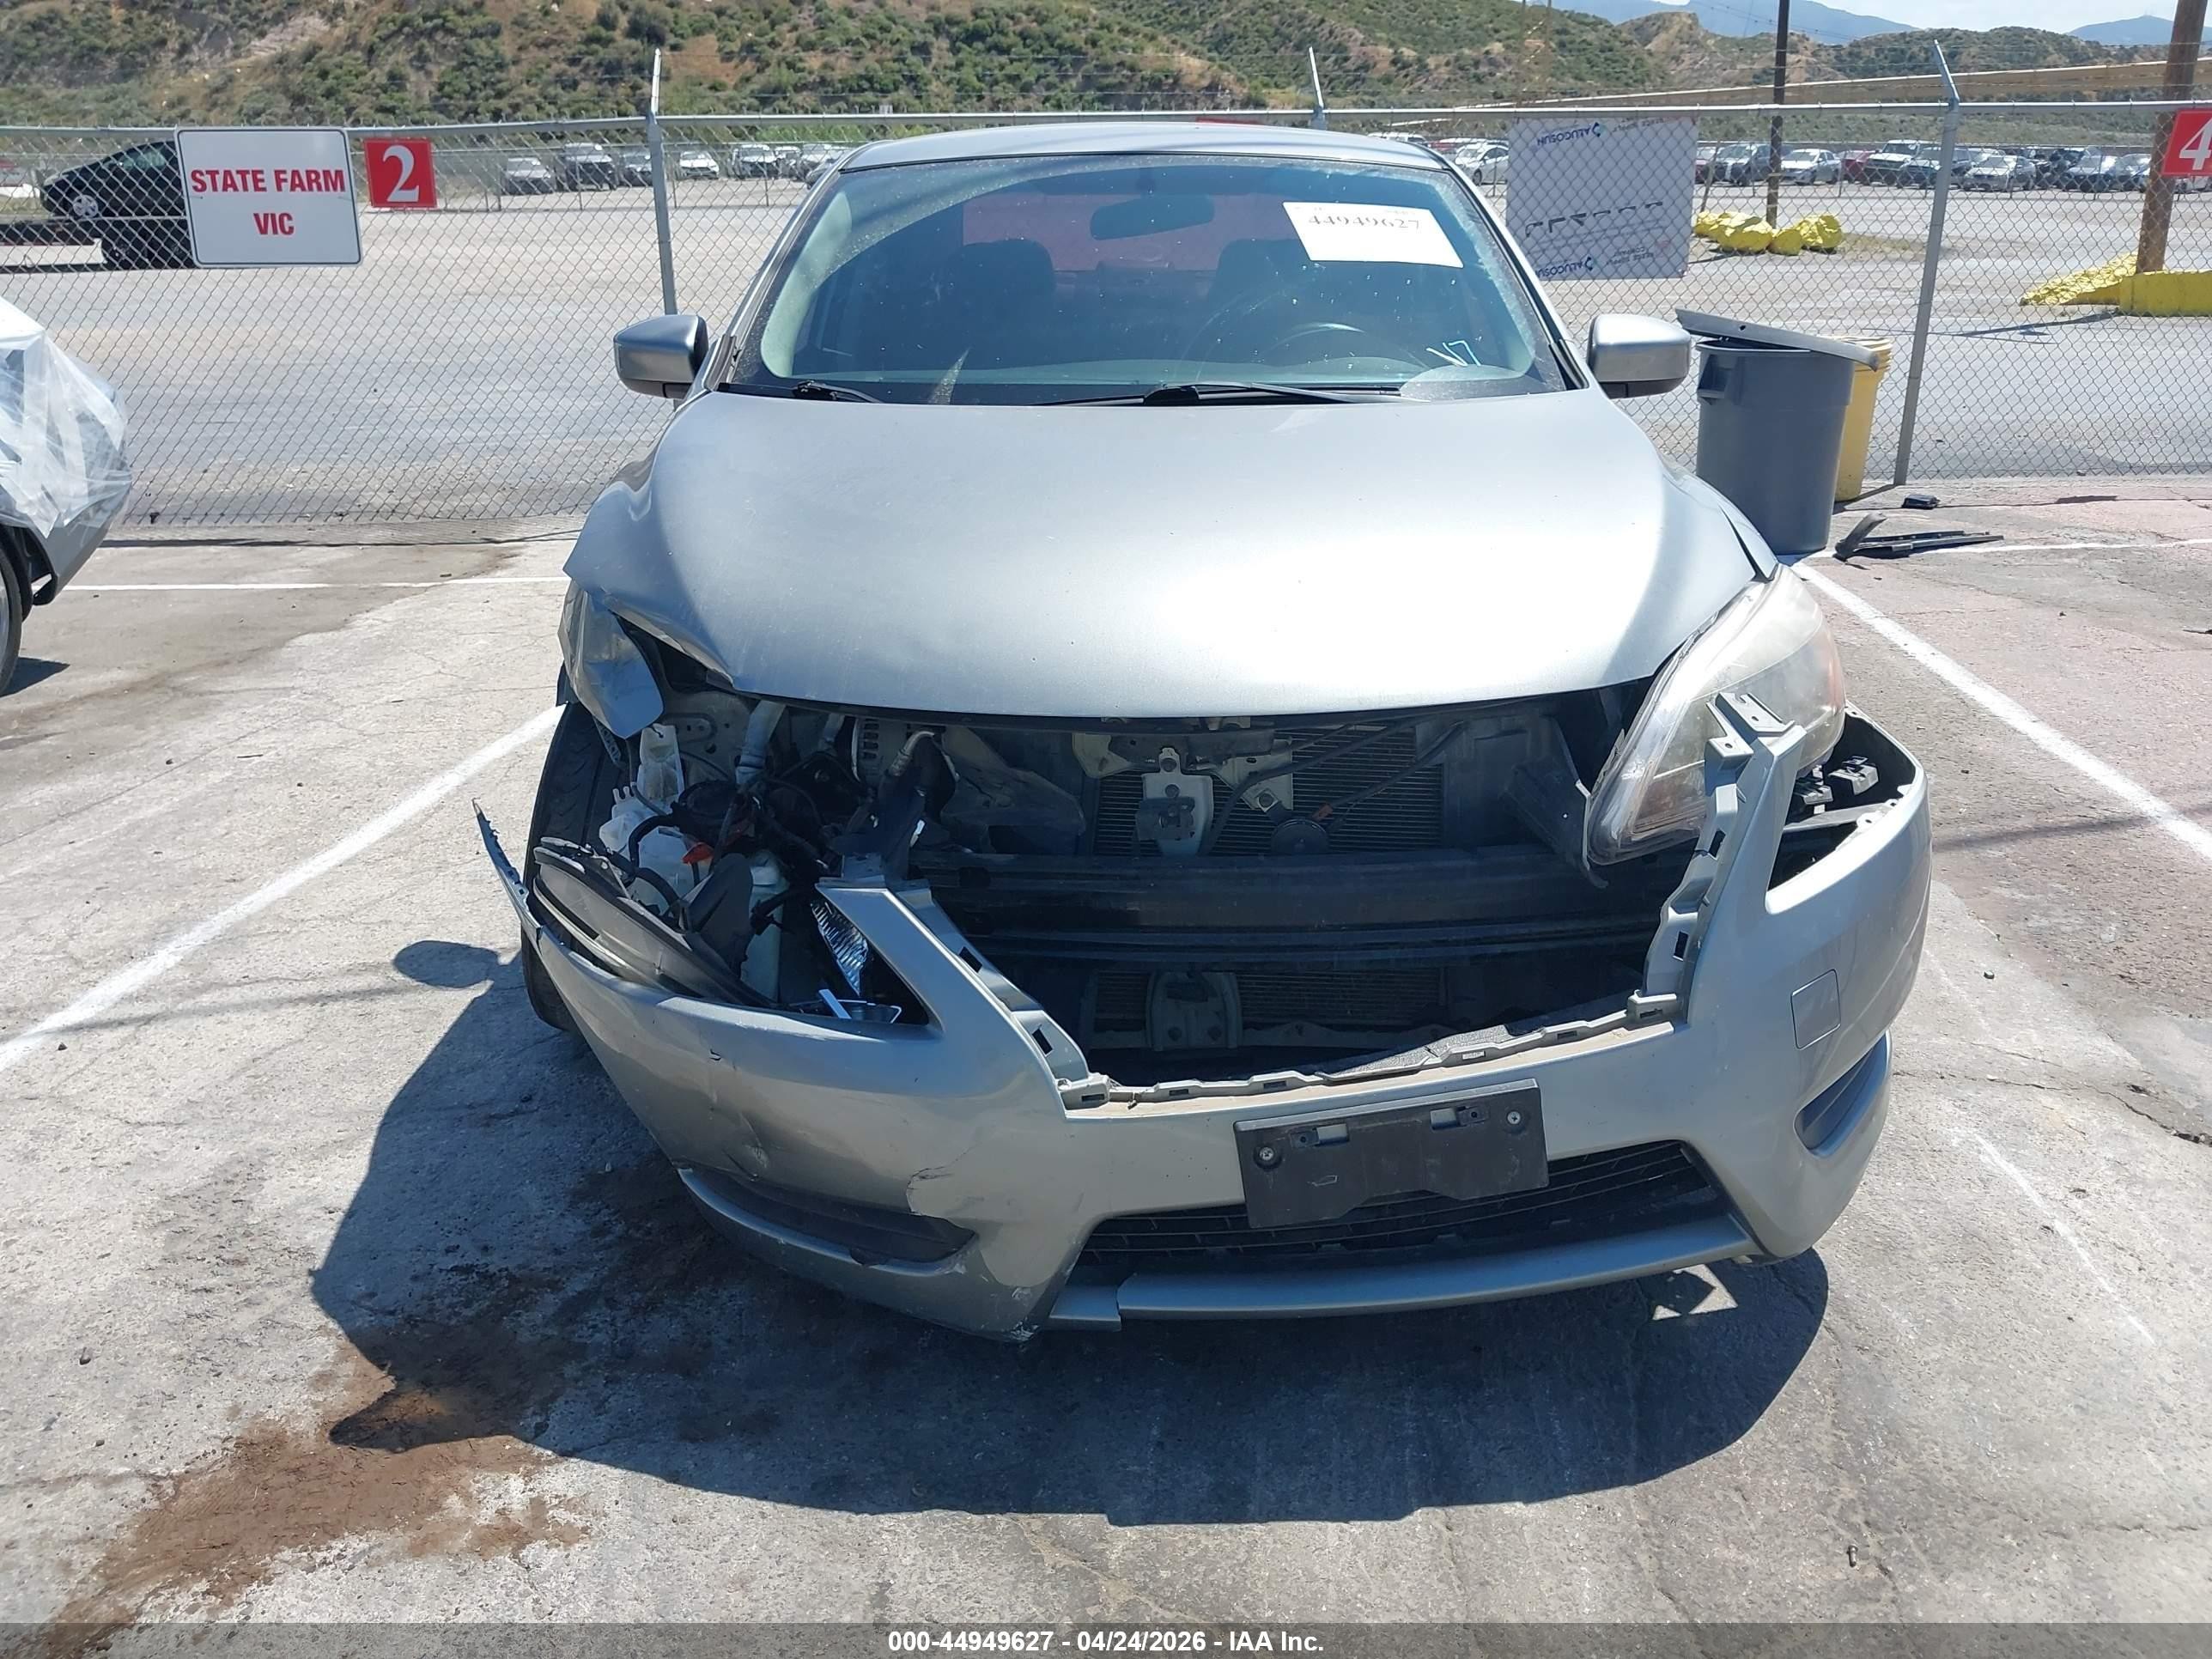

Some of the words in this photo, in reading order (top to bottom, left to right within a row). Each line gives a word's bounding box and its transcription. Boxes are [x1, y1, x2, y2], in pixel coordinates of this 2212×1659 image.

[2179, 118, 2212, 170] 4
[191, 169, 267, 193] STATE
[274, 169, 346, 193] FARM
[382, 144, 420, 203] 2
[253, 212, 295, 235] VIC
[1308, 215, 1419, 230] 44949627
